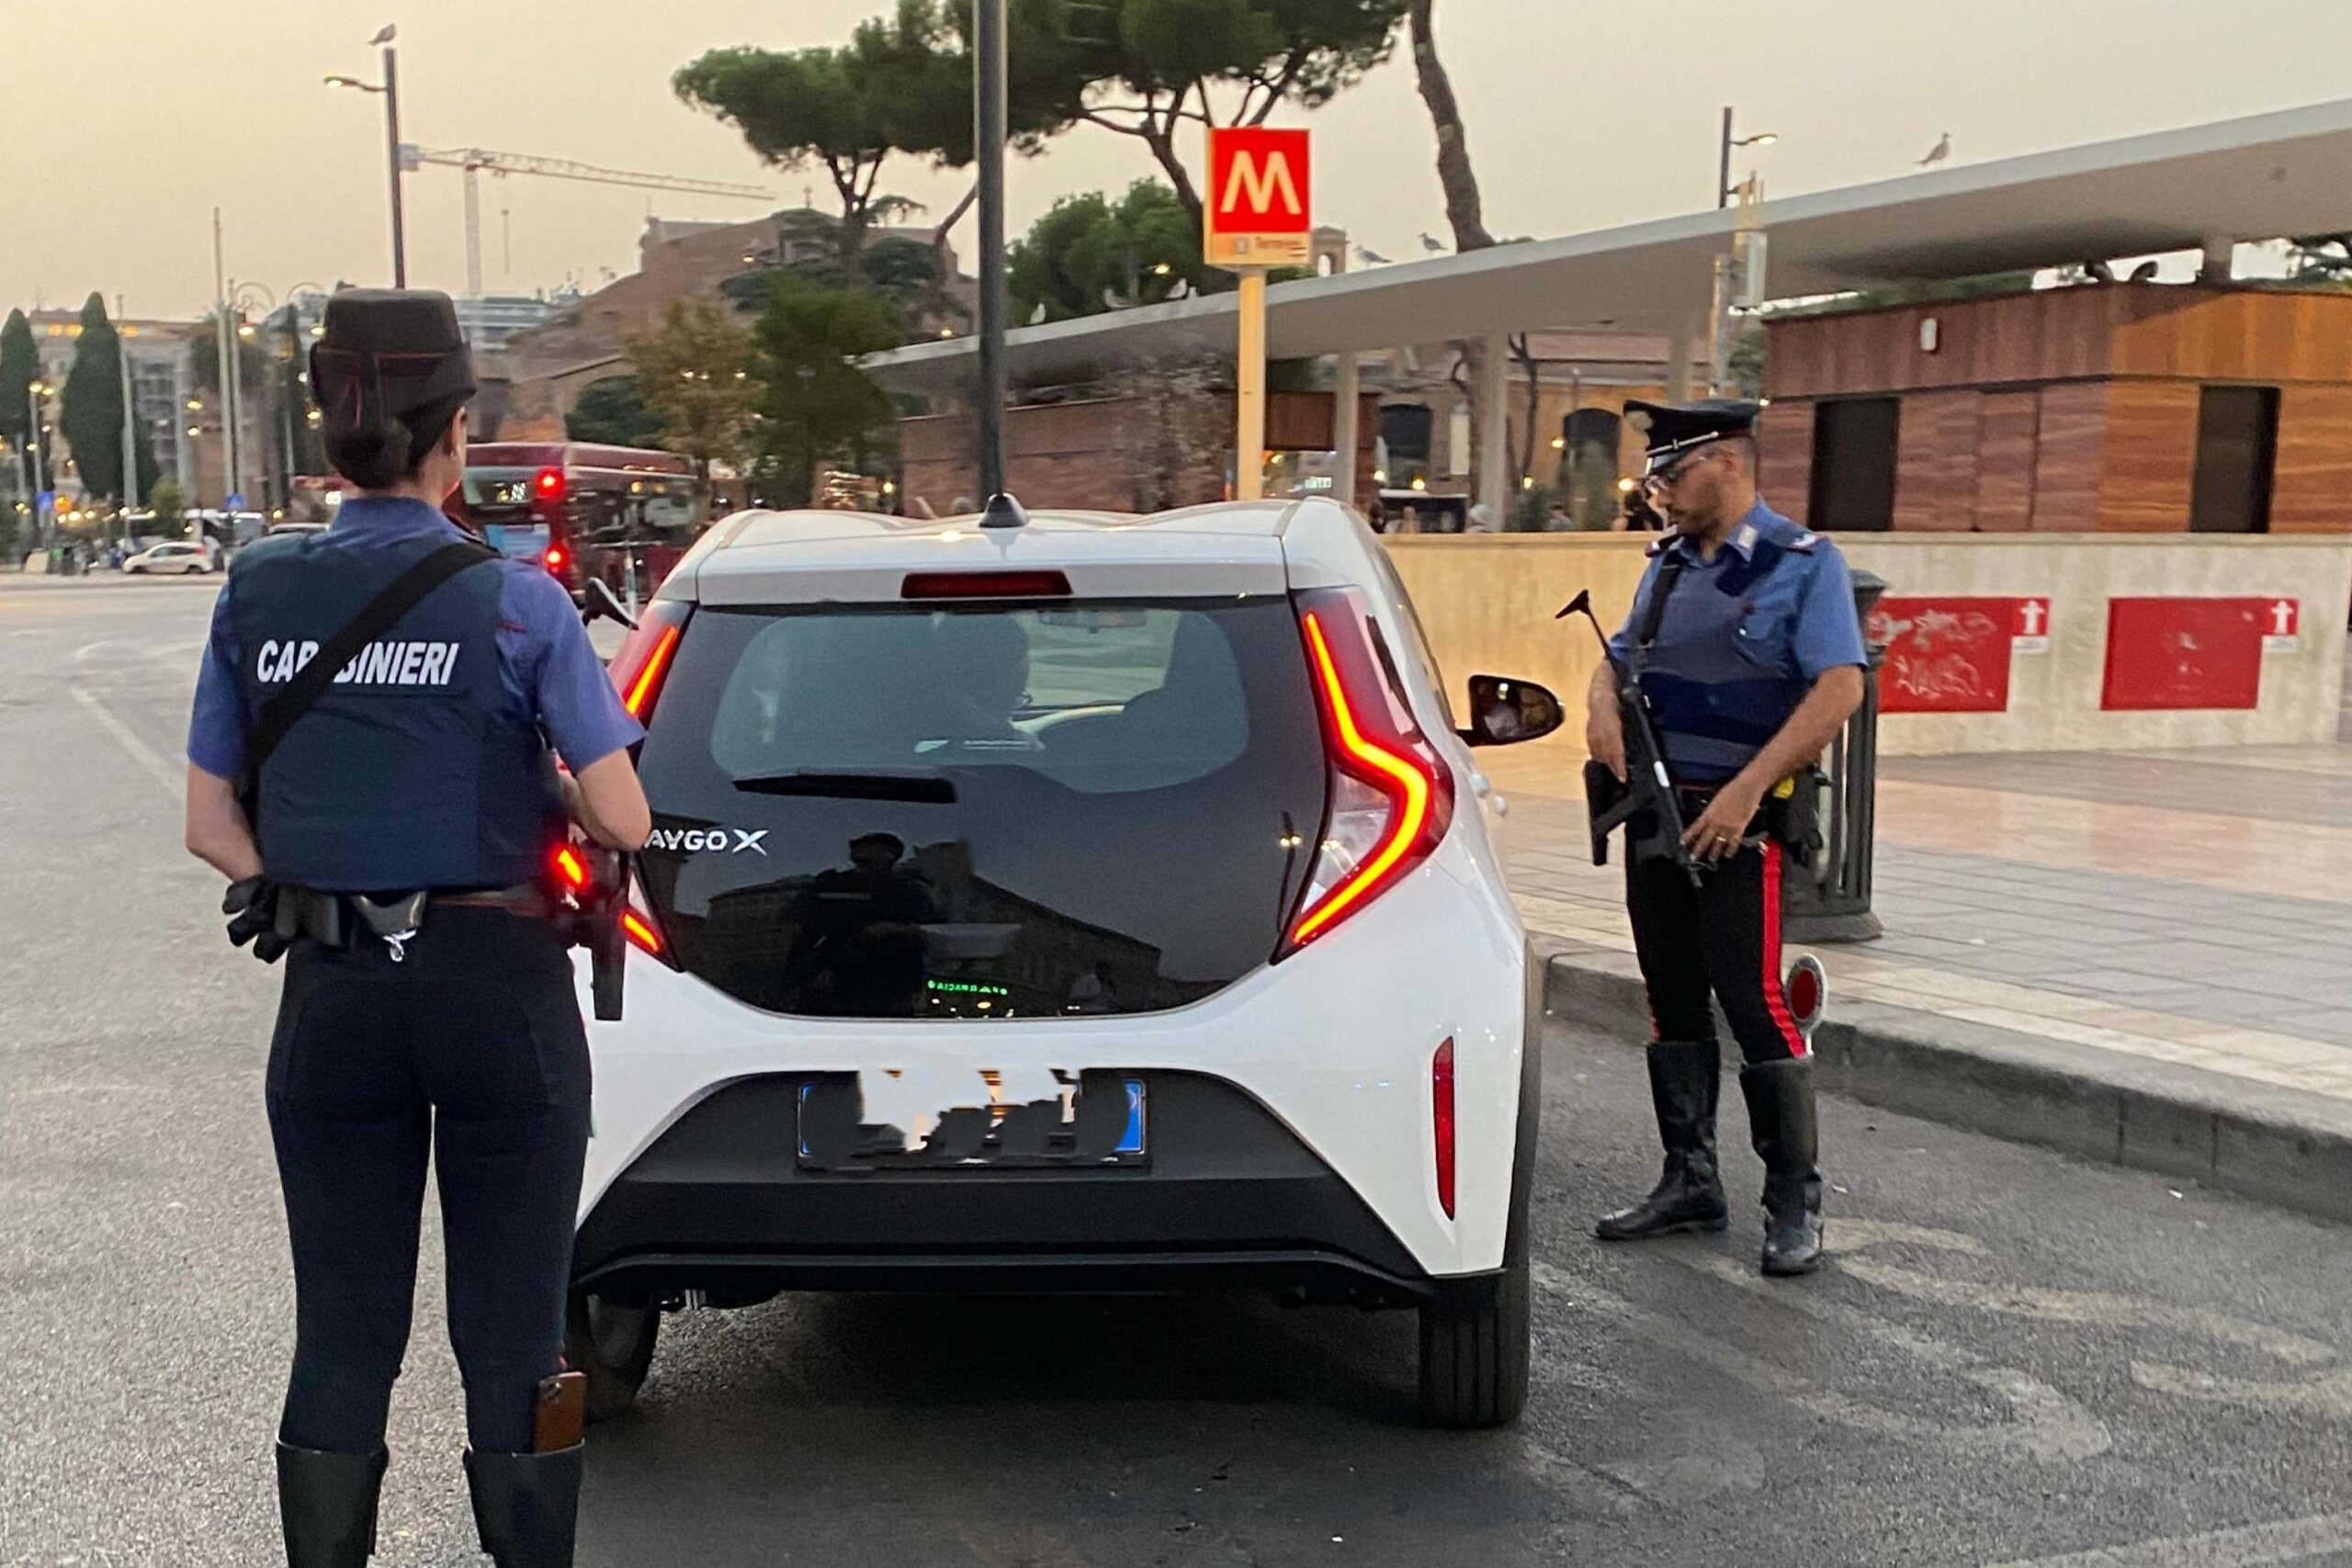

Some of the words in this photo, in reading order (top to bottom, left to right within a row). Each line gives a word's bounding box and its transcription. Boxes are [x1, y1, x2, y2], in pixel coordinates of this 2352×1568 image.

[1219, 150, 1302, 215] M
[256, 639, 460, 685] CARINIERI
[644, 829, 728, 851] AYGO
[731, 829, 770, 856] X
